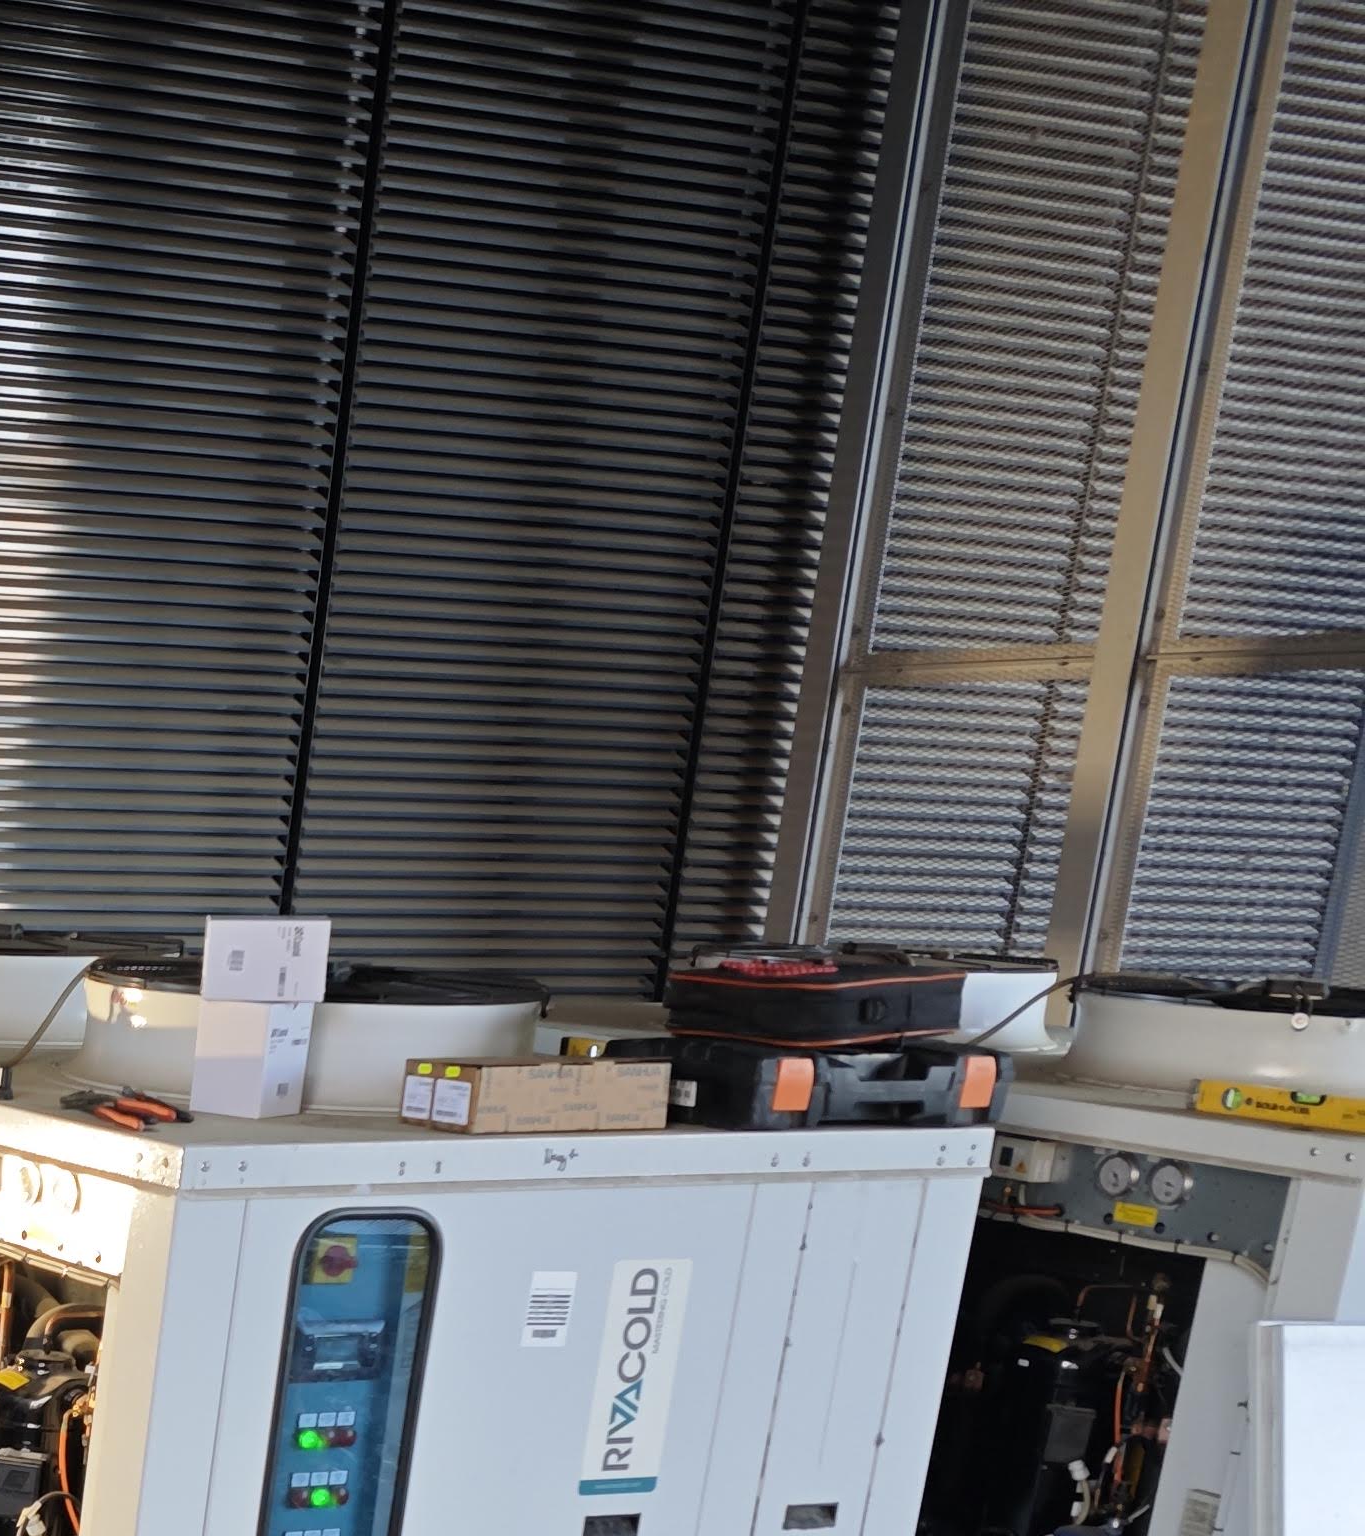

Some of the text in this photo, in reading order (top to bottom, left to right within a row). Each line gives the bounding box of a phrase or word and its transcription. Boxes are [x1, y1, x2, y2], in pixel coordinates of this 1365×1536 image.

[601, 1267, 660, 1471] RIVACOLD
[652, 1266, 673, 1354] MASTERING COLD
